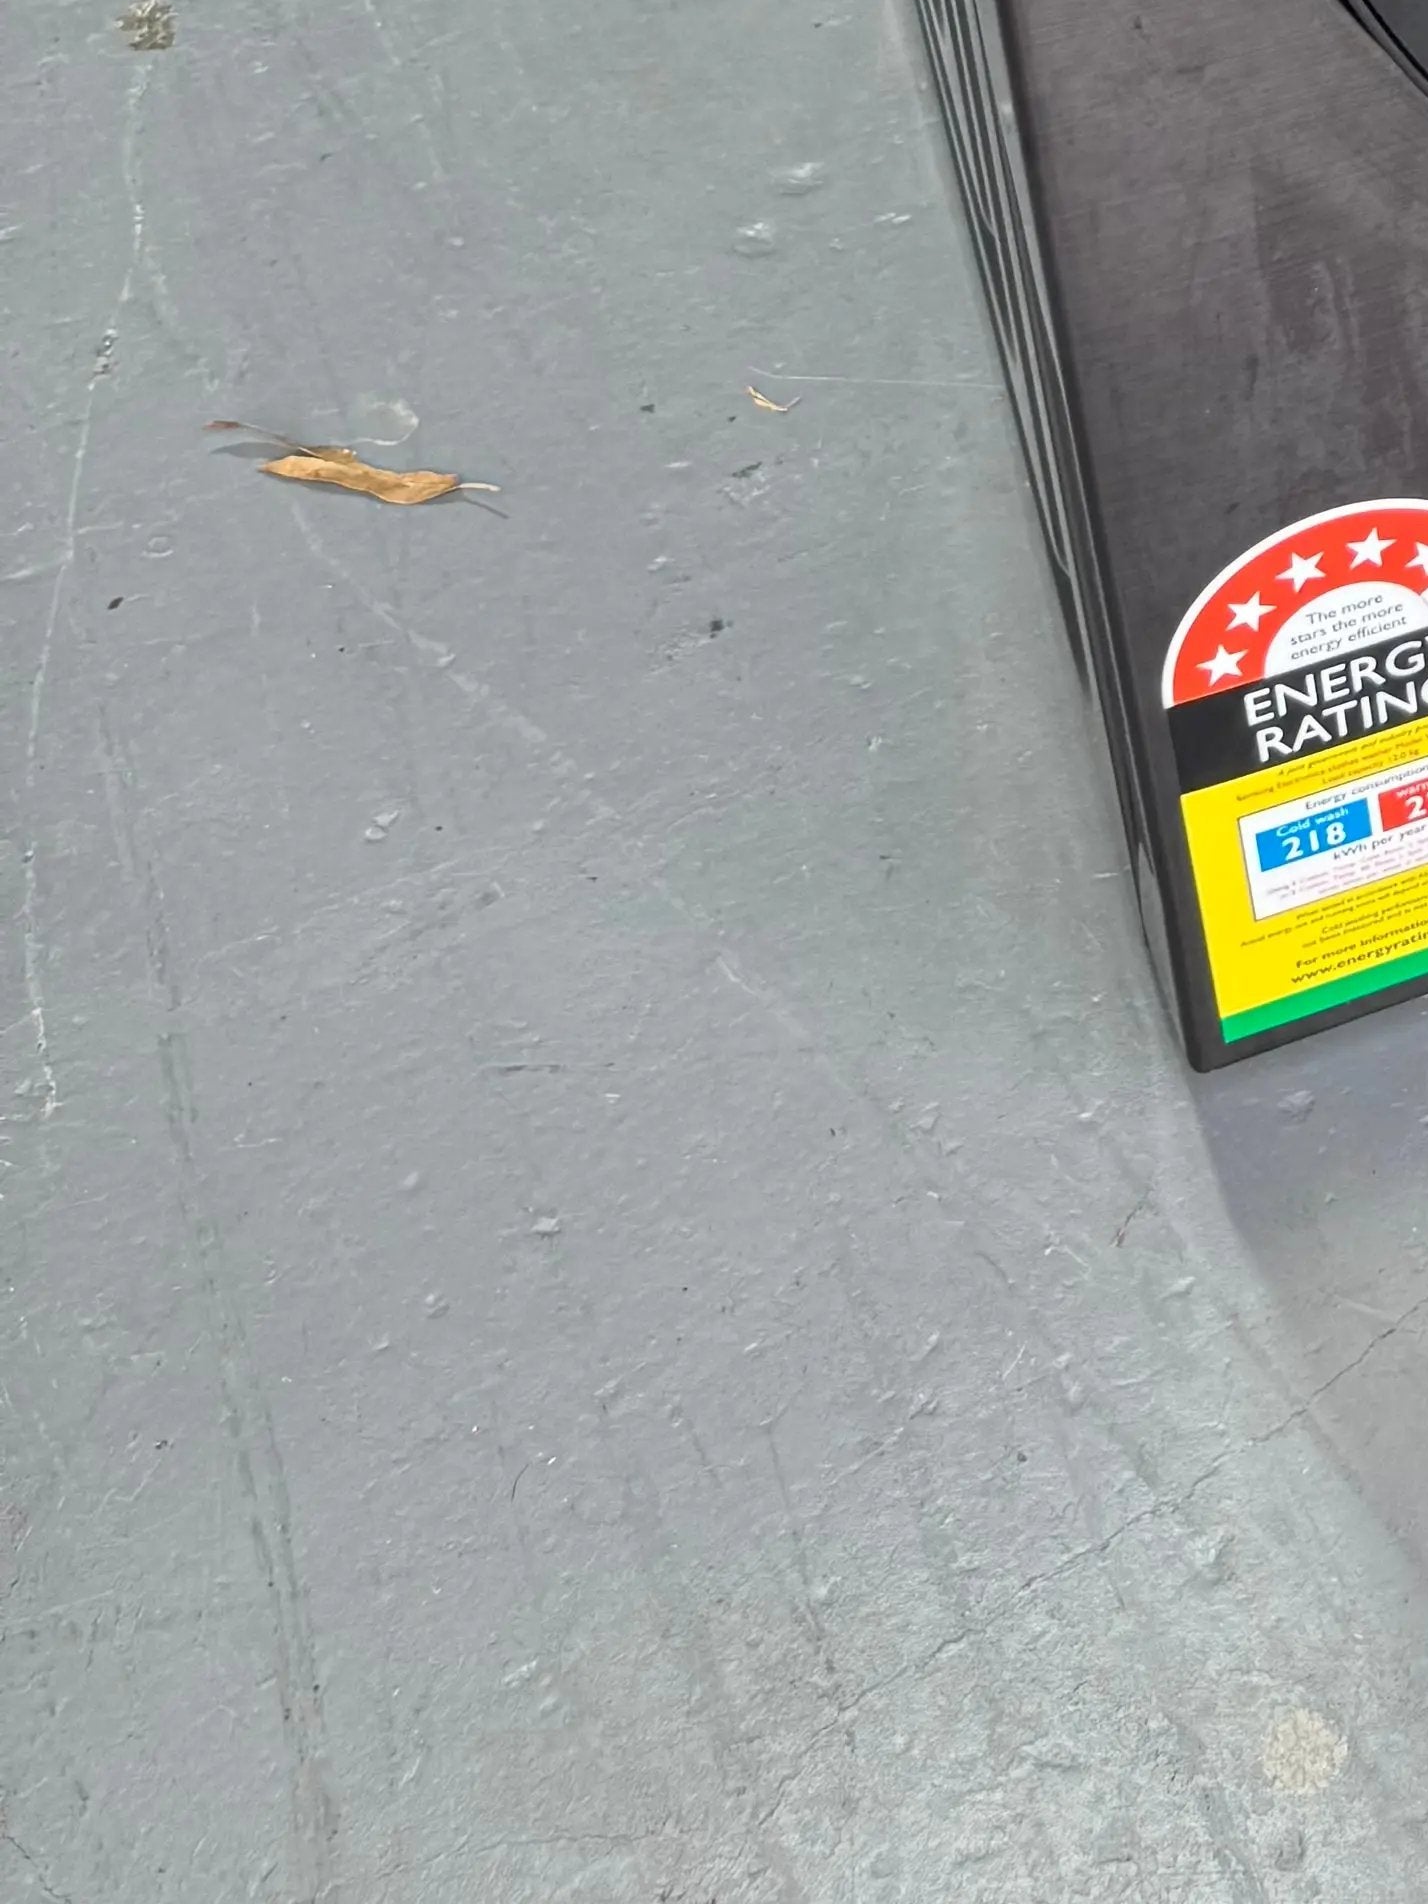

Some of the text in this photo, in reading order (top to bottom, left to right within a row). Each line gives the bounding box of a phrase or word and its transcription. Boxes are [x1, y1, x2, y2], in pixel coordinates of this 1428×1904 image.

[1289, 603, 1403, 646] stars the more
[1306, 594, 1383, 625] The more
[1290, 616, 1407, 660] energy efficient
[1305, 789, 1347, 811] Energy
[1275, 805, 1348, 838] Cold wash
[1280, 819, 1347, 862] 218
[1332, 823, 1427, 862] kWh per year
[1295, 954, 1317, 968] For
[1320, 941, 1356, 960] more
